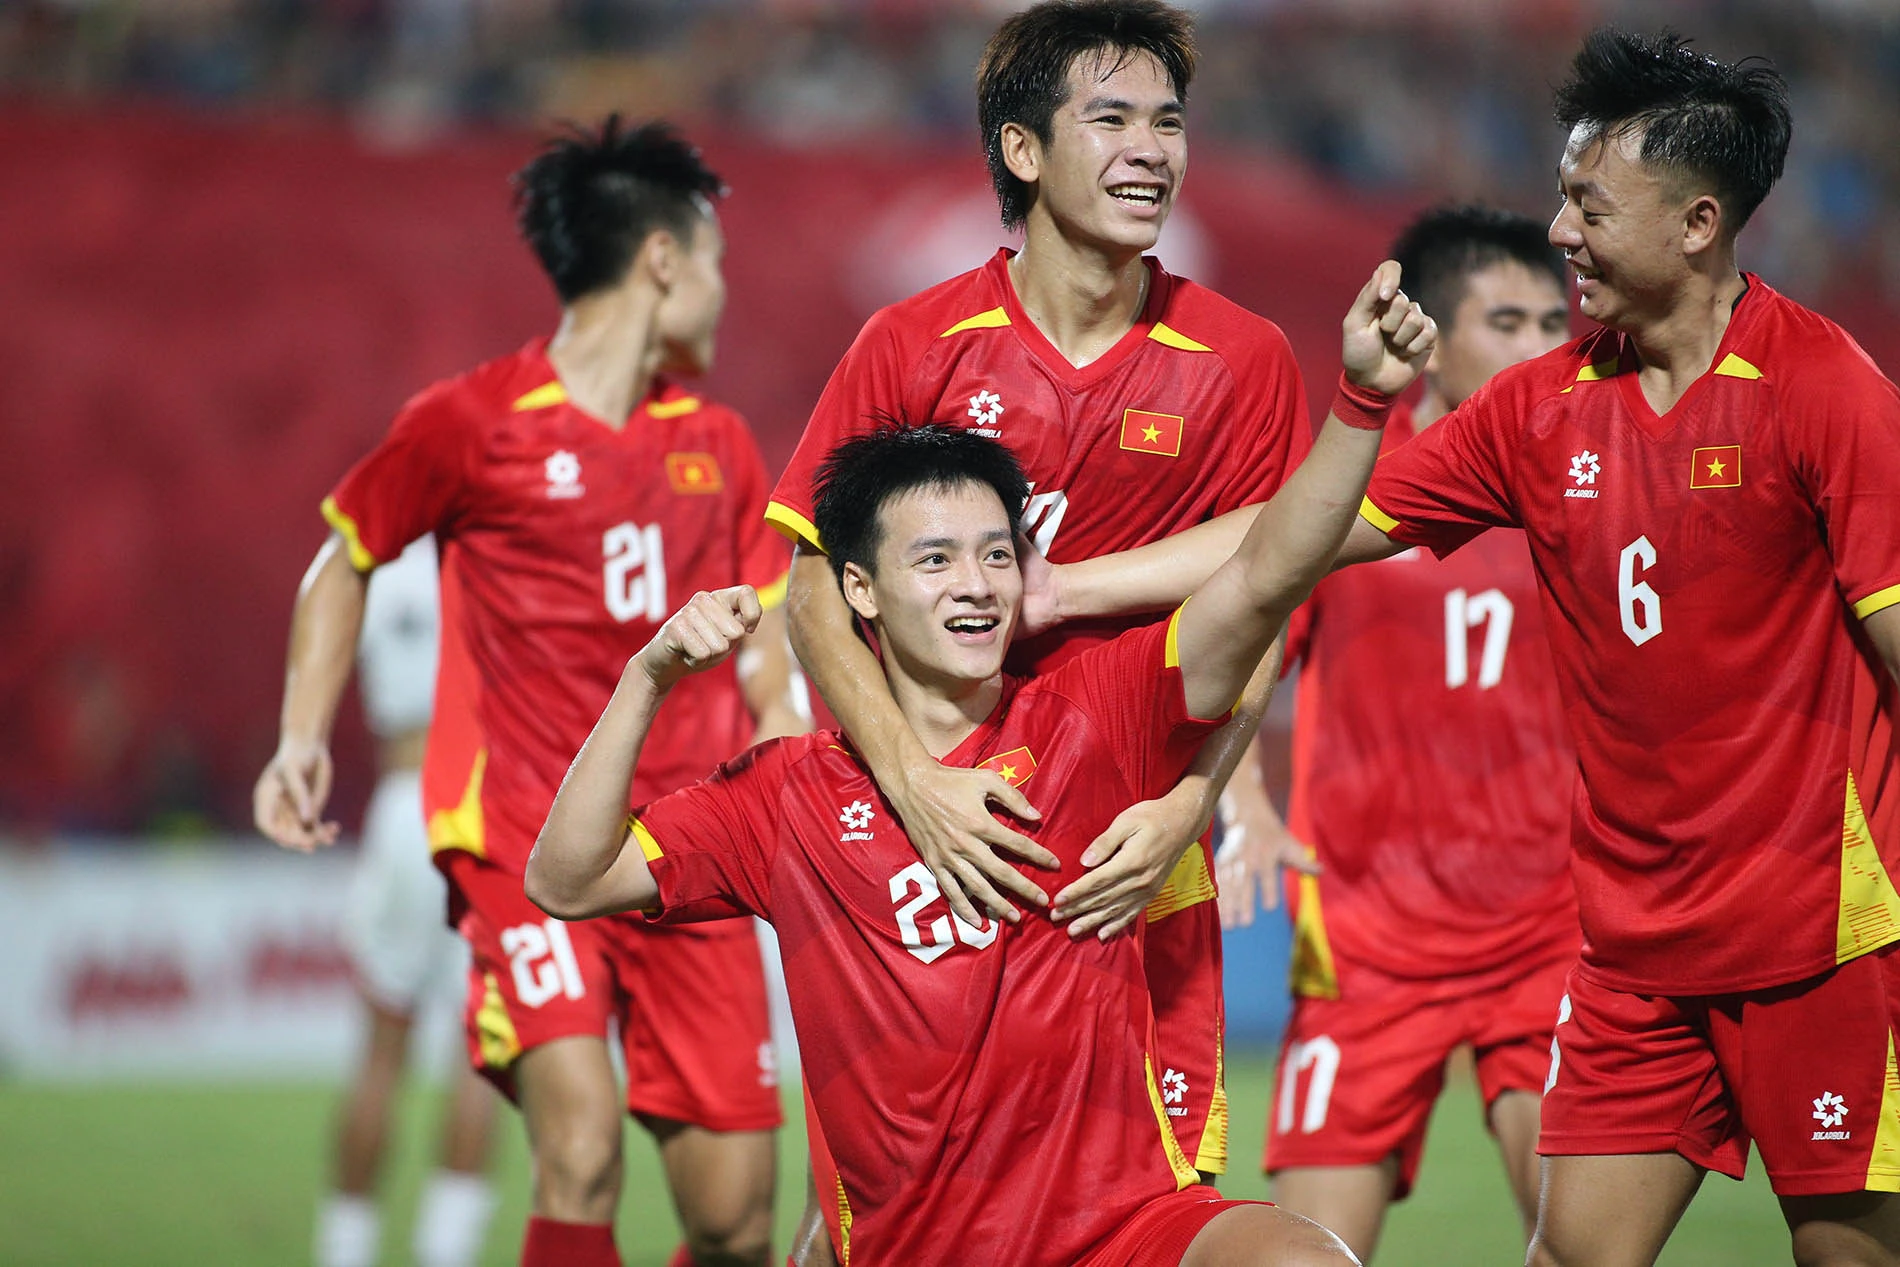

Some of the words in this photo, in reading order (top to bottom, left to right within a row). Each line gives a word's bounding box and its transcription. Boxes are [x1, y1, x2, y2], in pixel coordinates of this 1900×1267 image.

[603, 520, 667, 623] 21
[1618, 534, 1663, 647] 6
[1443, 587, 1514, 690] 17
[500, 916, 586, 1009] 21
[1278, 1034, 1341, 1135] 17
